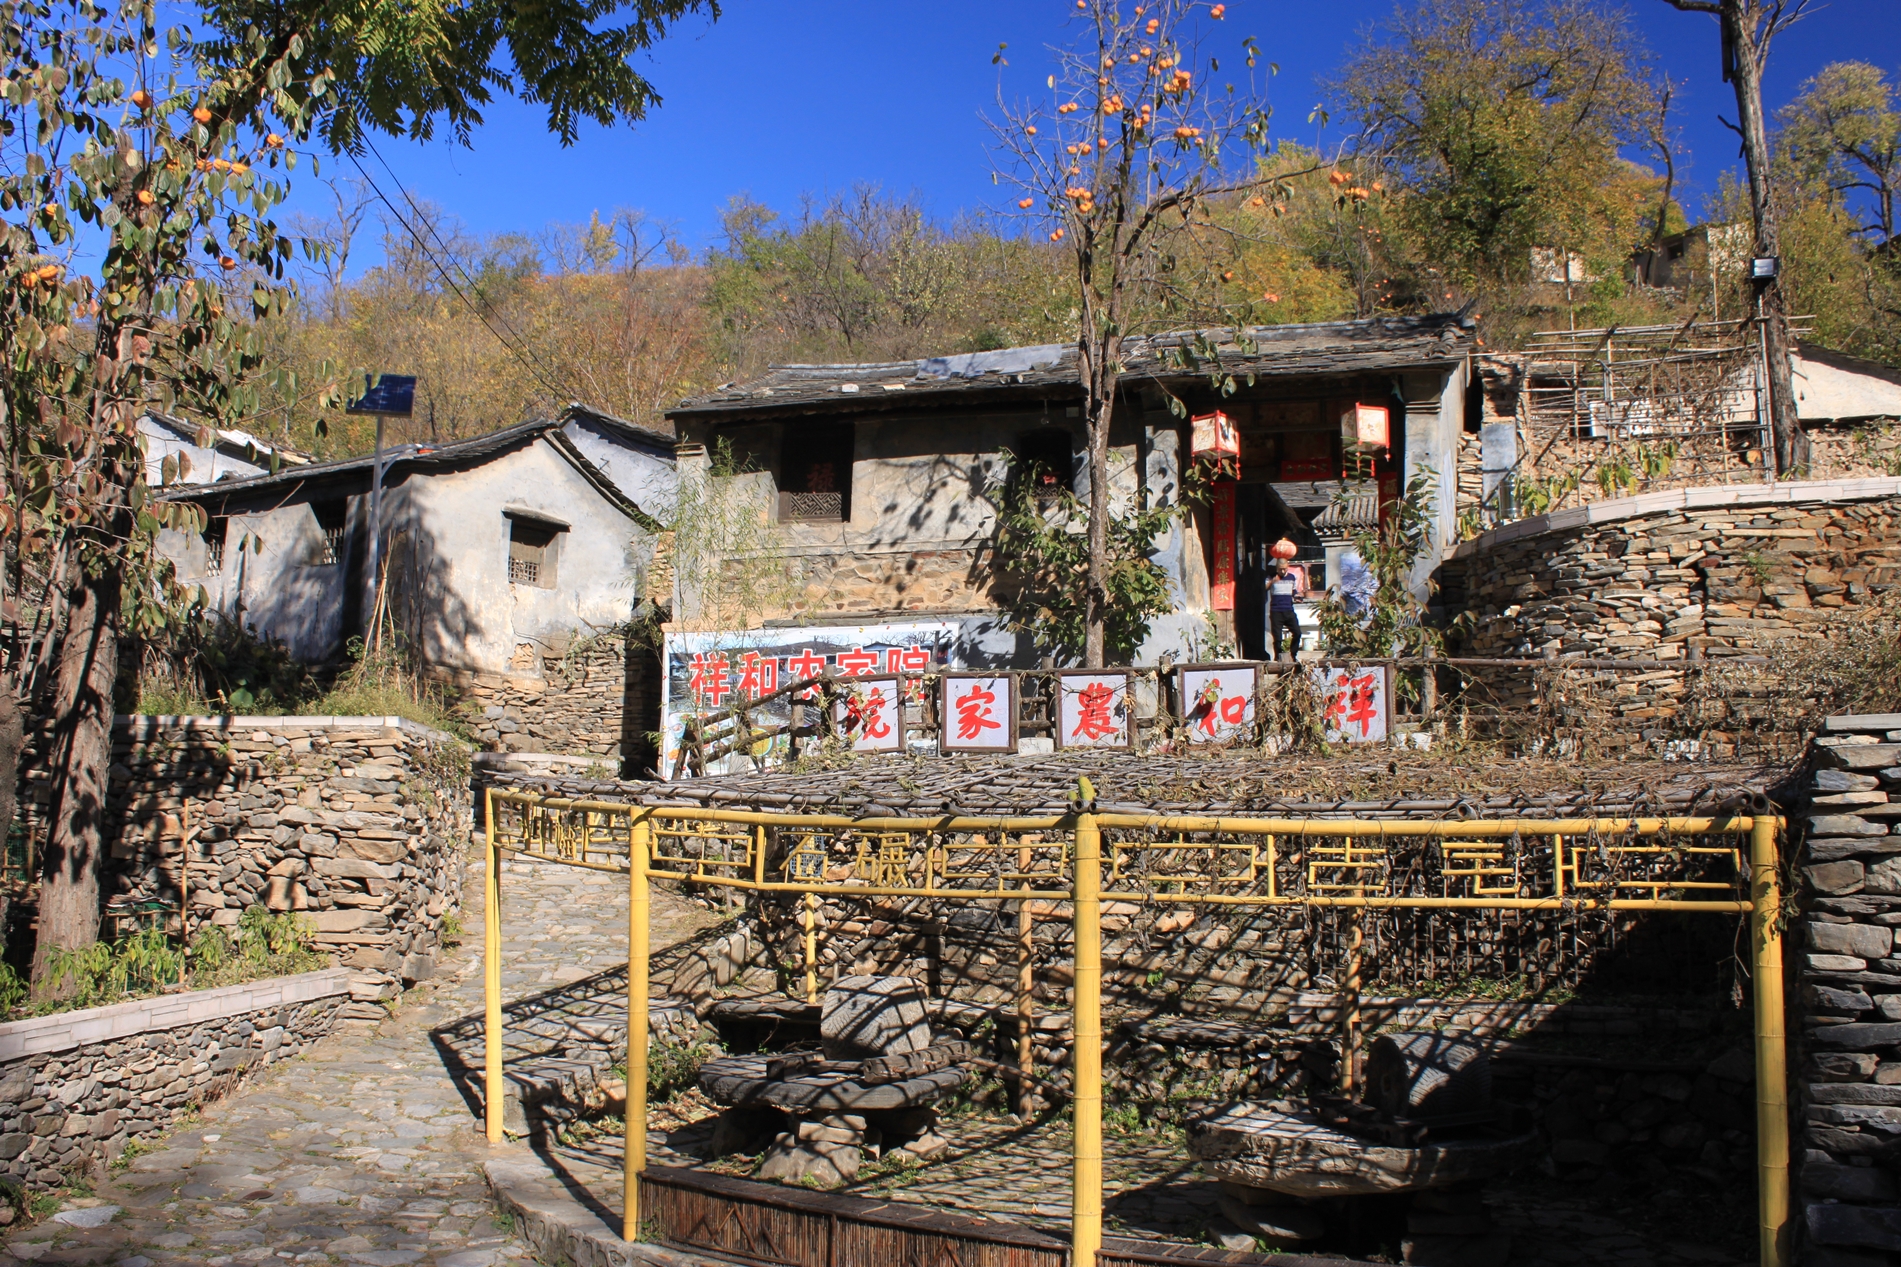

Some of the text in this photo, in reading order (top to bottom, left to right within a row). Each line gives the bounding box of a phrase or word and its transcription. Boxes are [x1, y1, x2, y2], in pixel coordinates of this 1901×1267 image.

[689, 645, 931, 707] 祥和农家院
[847, 686, 891, 741] 院
[955, 685, 1002, 740] 家
[1198, 678, 1246, 737] 和
